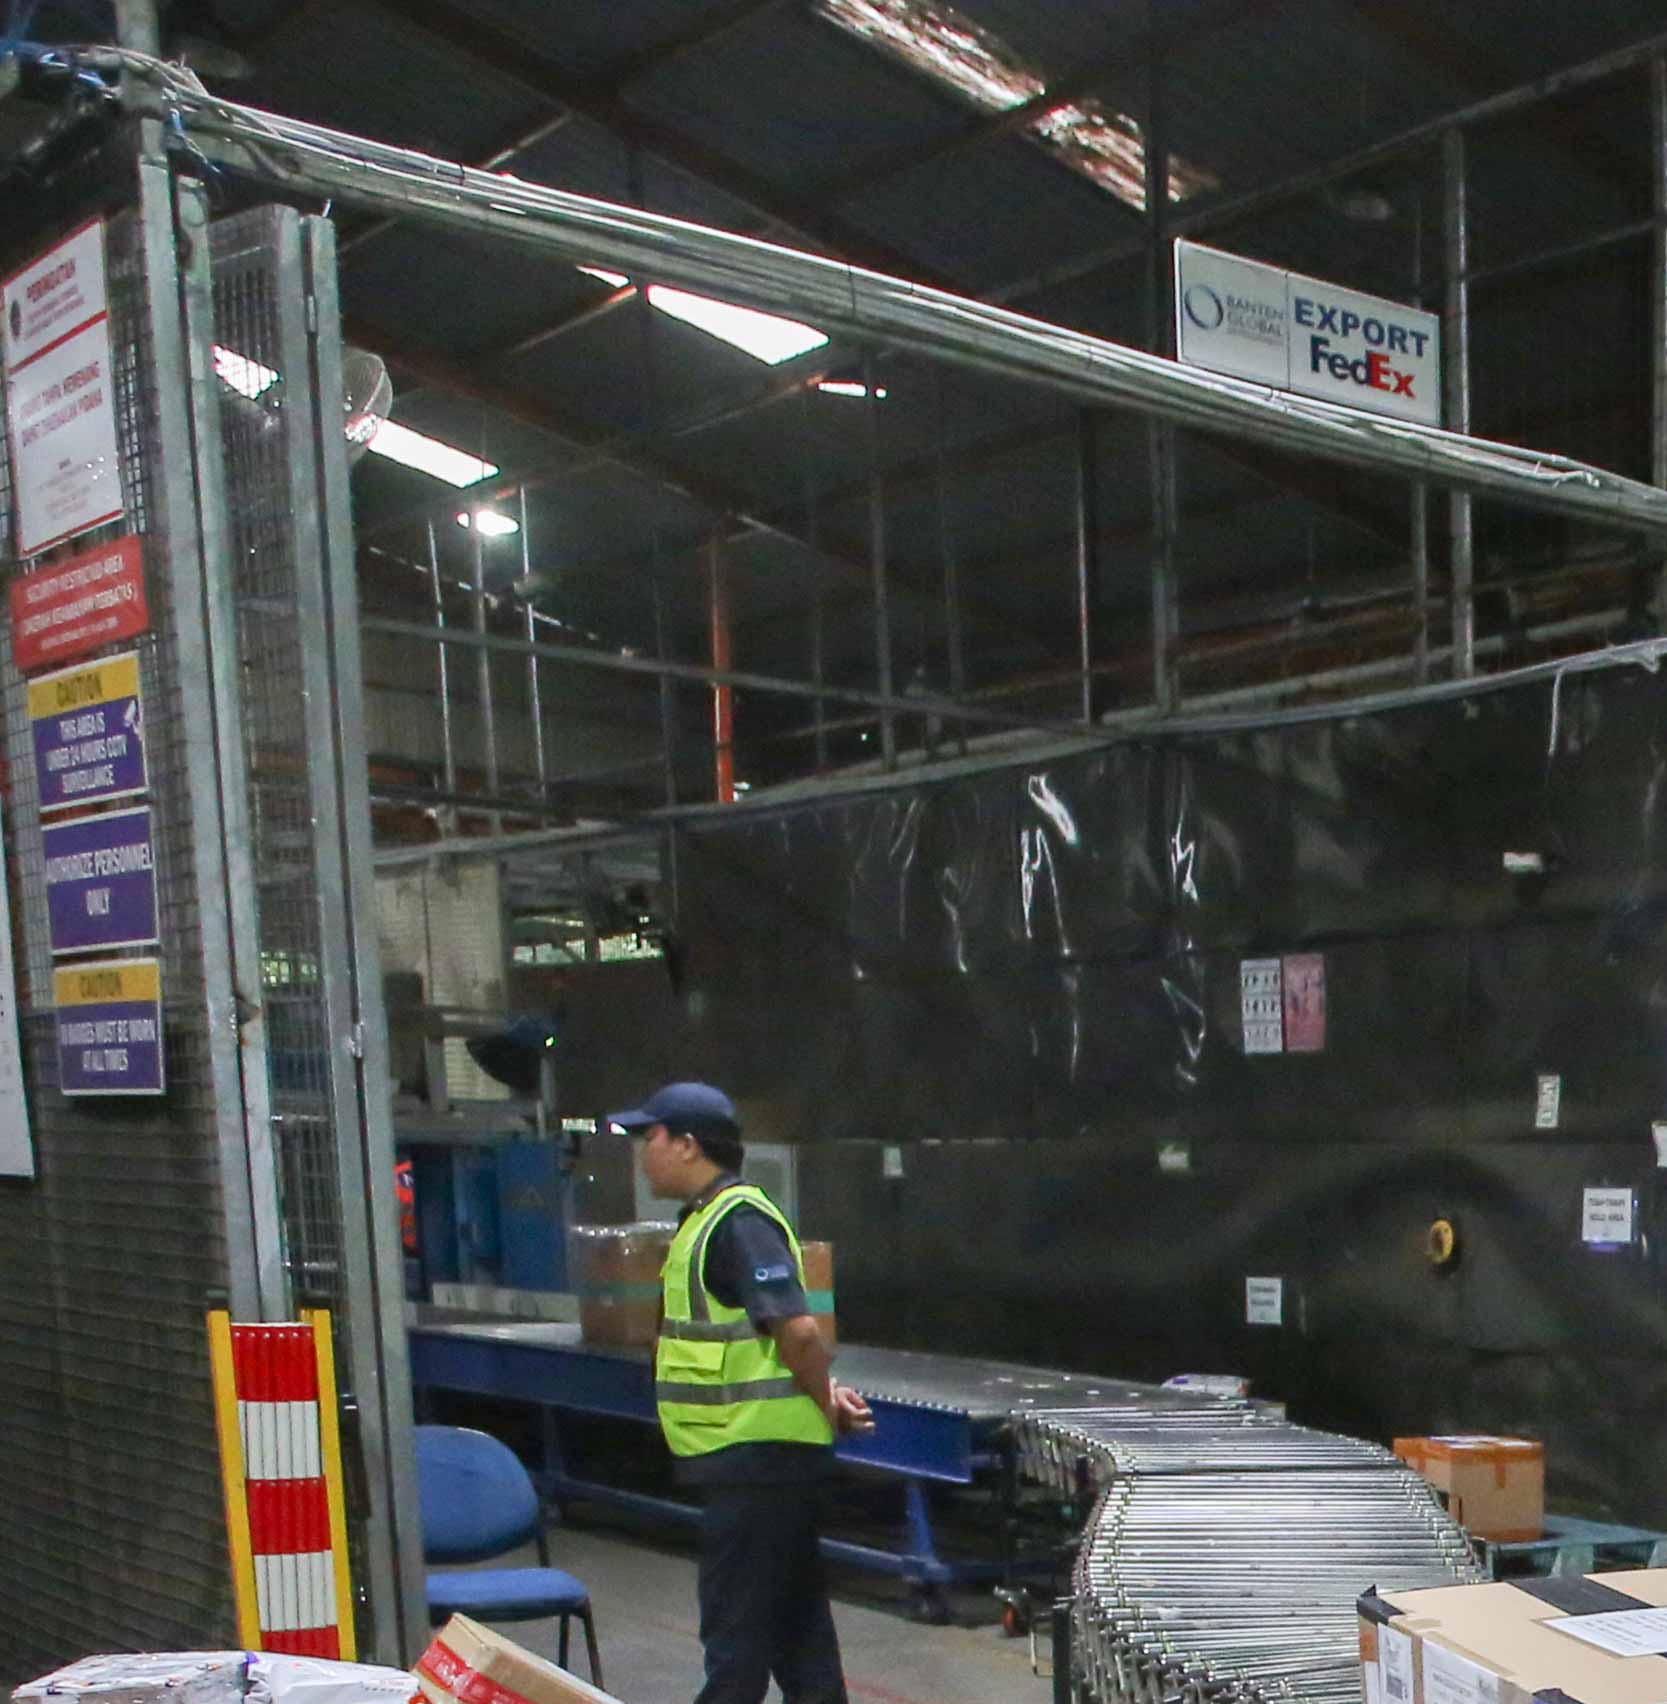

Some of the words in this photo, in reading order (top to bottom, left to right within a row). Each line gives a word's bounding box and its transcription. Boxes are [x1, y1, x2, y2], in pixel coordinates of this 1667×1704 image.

[1294, 296, 1429, 358] EXPORT
[1309, 333, 1417, 400] FedEx
[56, 670, 103, 708] CAUTION
[60, 719, 77, 741] THIS
[77, 714, 96, 737] AREA
[96, 711, 105, 734] IS
[80, 738, 106, 763] HOURS
[95, 842, 153, 876] PERSONNEL
[86, 887, 111, 917] ONLY
[80, 971, 123, 999] CAUTION
[96, 1020, 118, 1043] MUST
[118, 1019, 128, 1042] BE
[129, 1018, 156, 1041] WORN
[104, 1048, 129, 1071] TIMES
